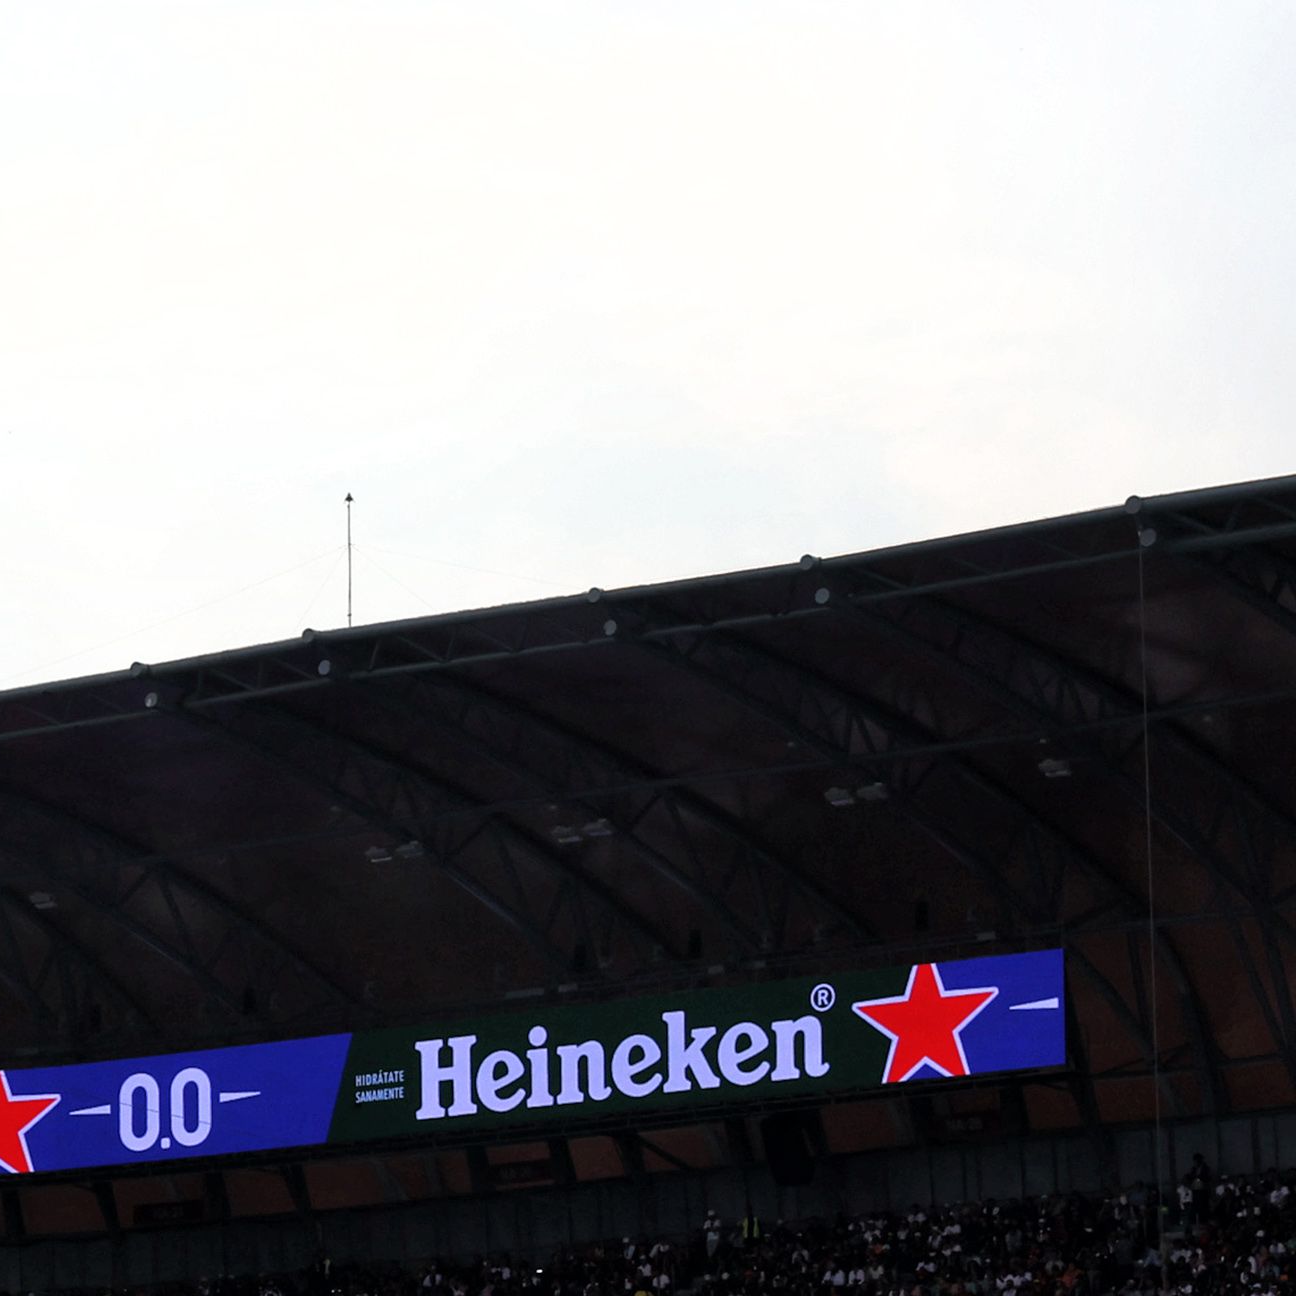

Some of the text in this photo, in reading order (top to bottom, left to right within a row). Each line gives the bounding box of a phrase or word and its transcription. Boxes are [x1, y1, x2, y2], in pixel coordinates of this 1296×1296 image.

[355, 1070, 405, 1087] HIDRÁTATE
[355, 1086, 405, 1103] SANAMENTE
[119, 1067, 212, 1152] 0.0
